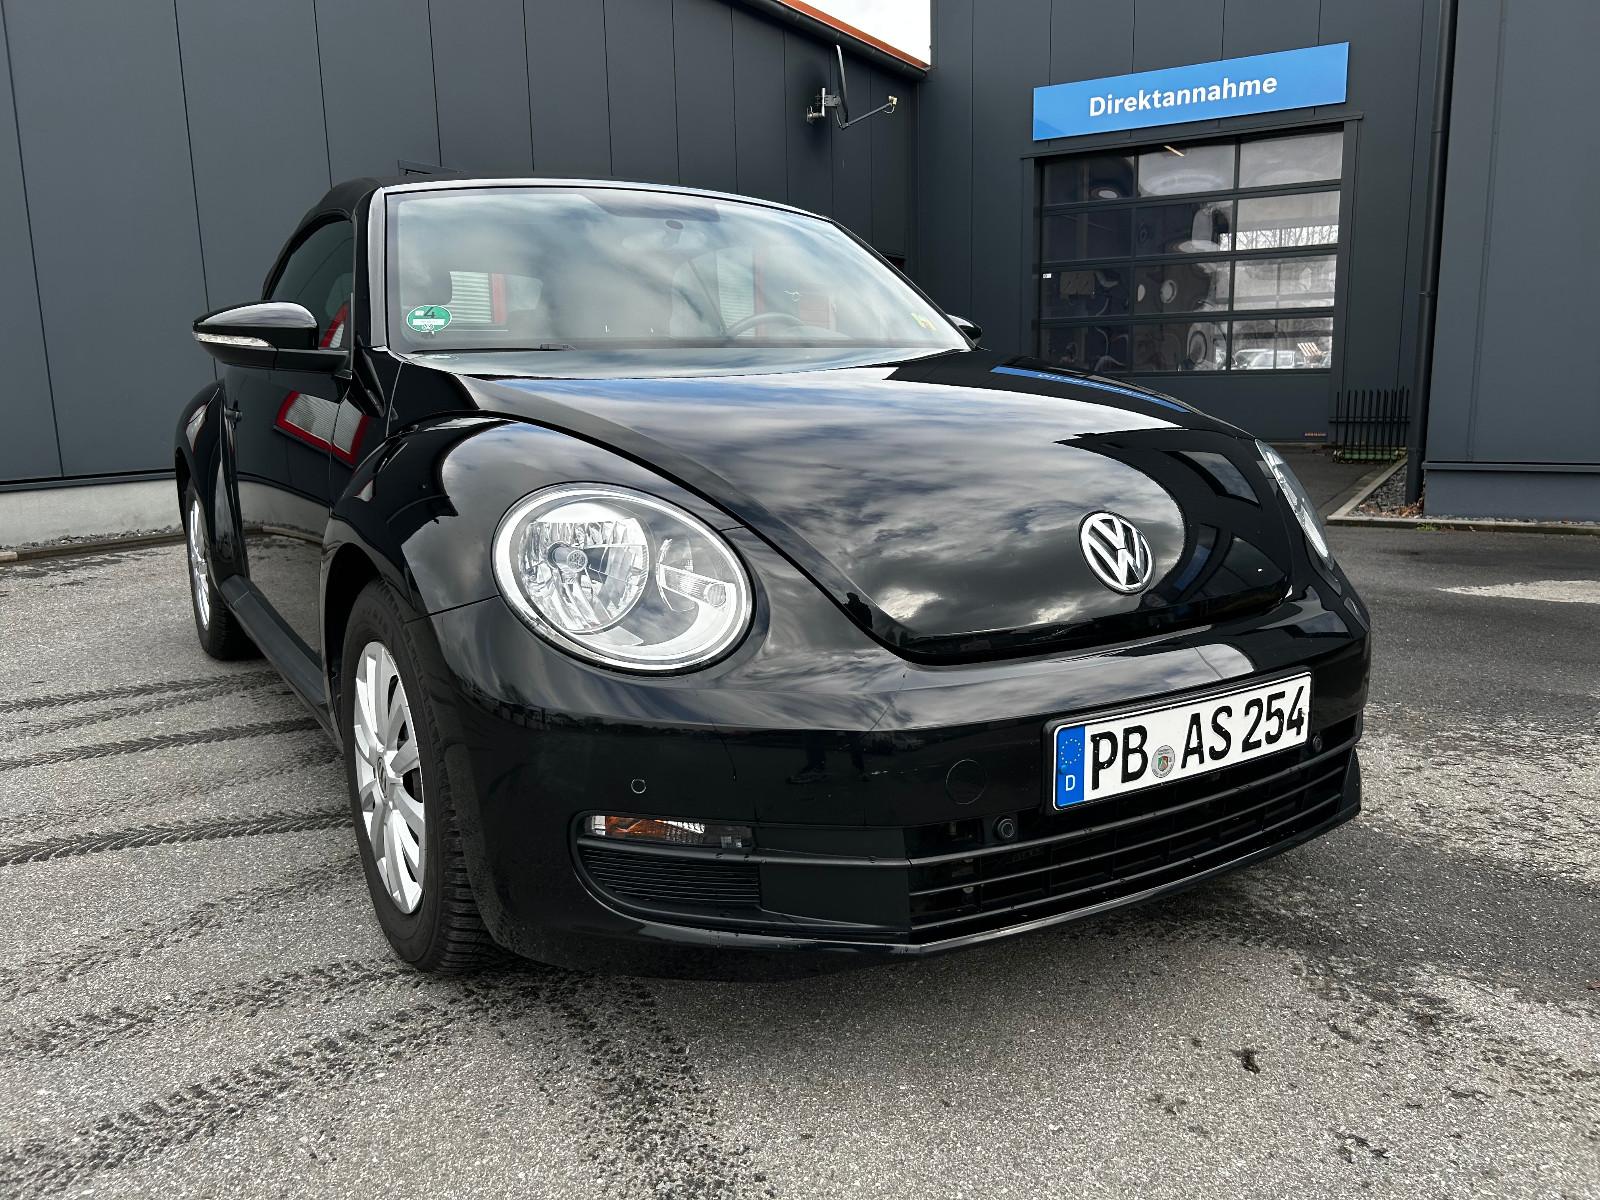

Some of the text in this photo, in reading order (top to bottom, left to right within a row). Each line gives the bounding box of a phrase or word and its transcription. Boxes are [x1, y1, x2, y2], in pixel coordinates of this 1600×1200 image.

[1089, 77, 1278, 117] Direktannahme
[423, 307, 436, 319] 4
[1090, 686, 1304, 790] PB AS 254
[1065, 775, 1076, 792] D
